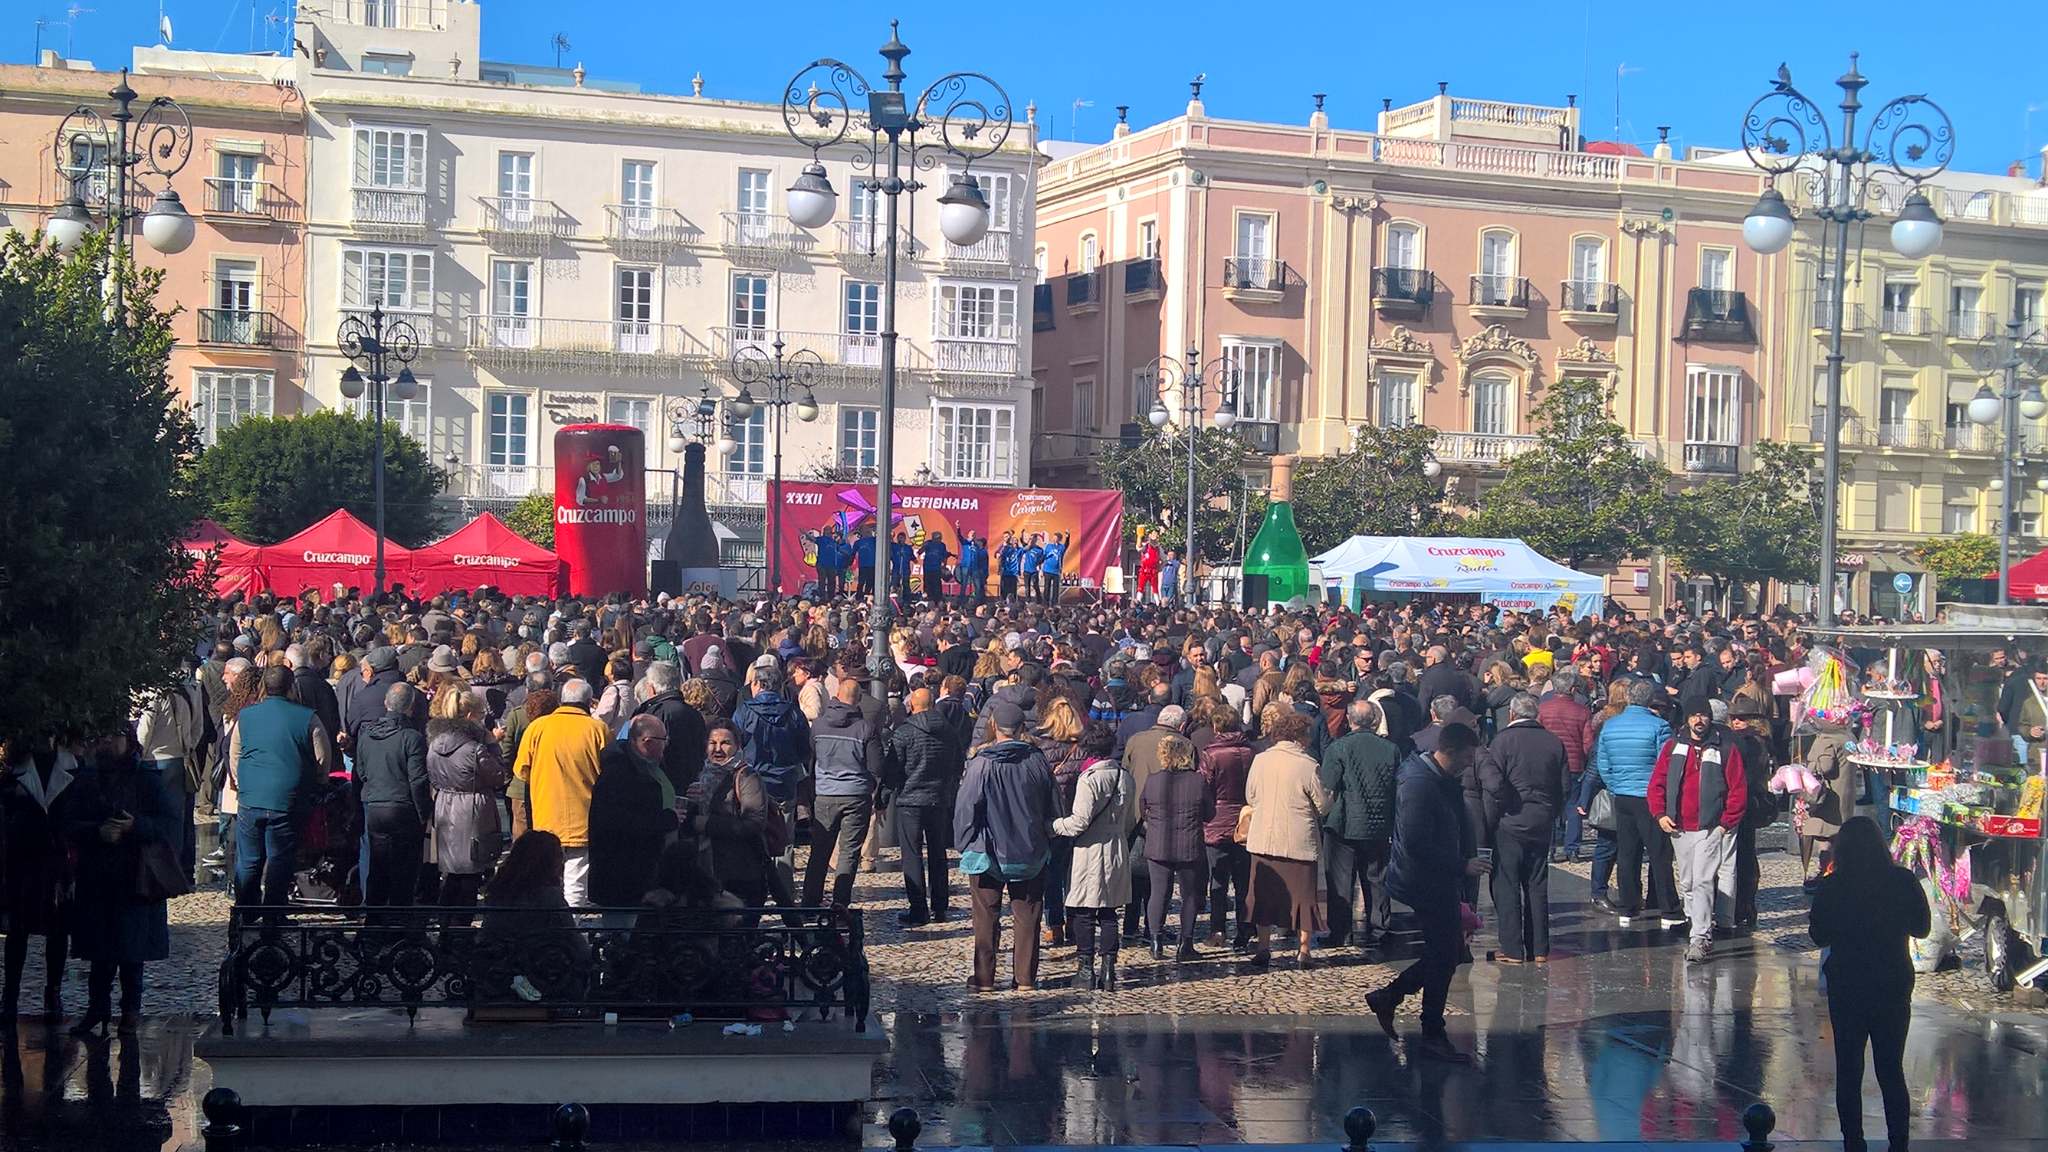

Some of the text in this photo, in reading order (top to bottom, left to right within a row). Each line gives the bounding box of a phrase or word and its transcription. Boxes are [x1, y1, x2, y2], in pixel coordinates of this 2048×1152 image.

[785, 493, 822, 504] XXXII
[557, 505, 636, 526] Cruzcampo
[303, 550, 371, 566] Cruzcampo
[1428, 546, 1505, 558] Cruzcampo
[453, 554, 520, 568] Cruzcampo
[1492, 599, 1536, 609] Cruzcampo
